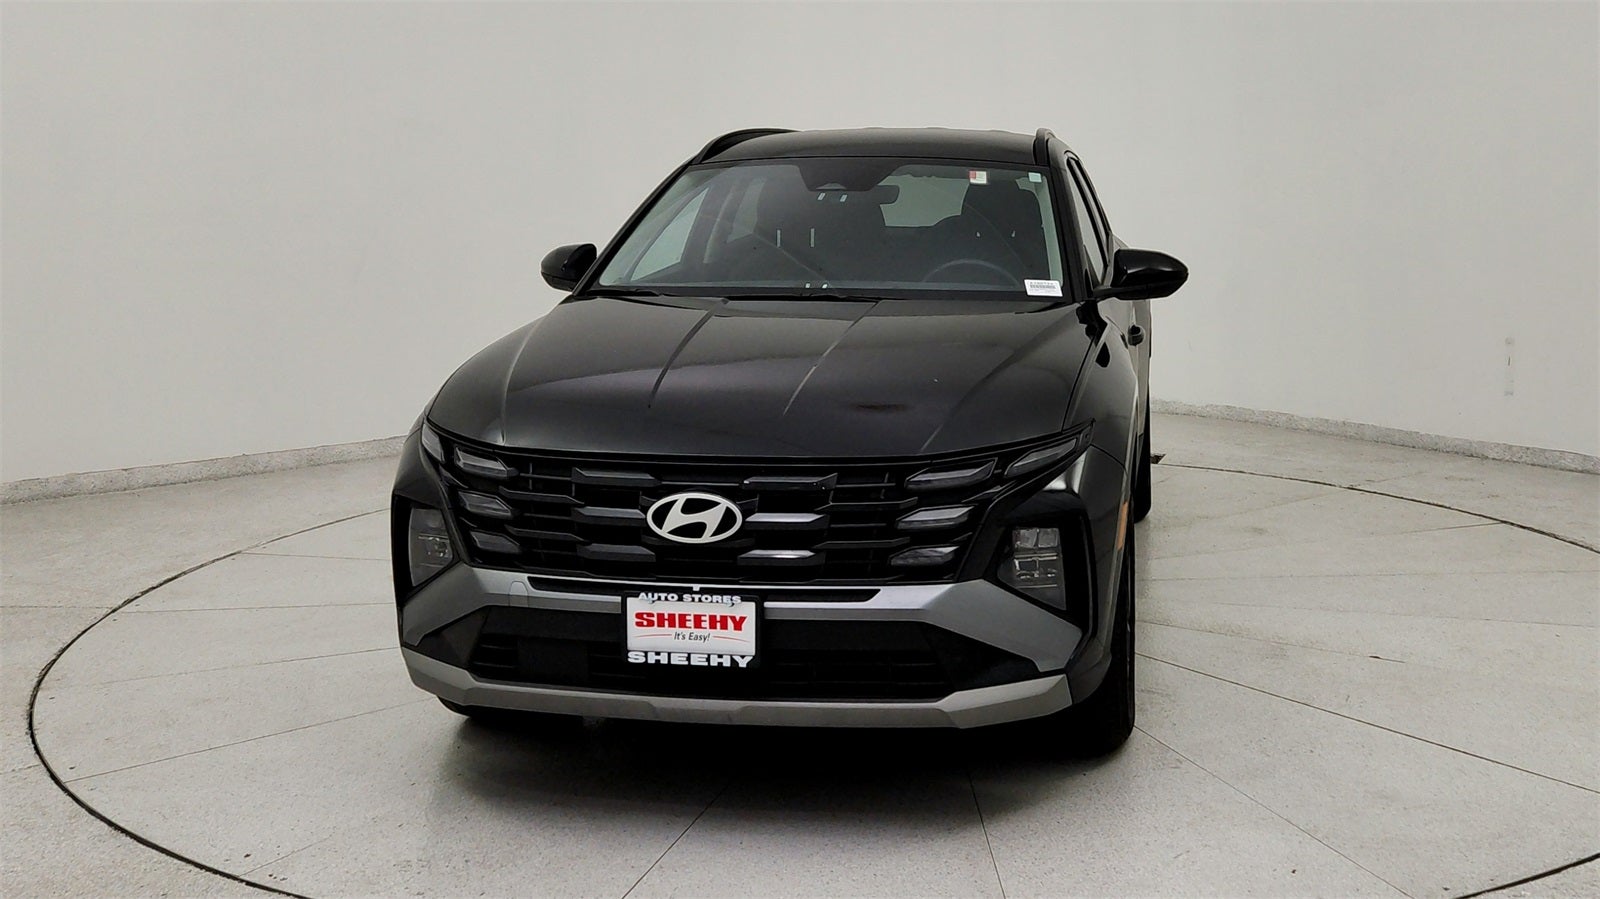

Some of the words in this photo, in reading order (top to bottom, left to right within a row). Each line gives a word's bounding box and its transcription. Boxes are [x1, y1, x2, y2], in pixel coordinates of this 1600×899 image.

[639, 592, 679, 602] AUTO
[682, 593, 741, 604] STORES
[635, 612, 748, 631] SHEEHY
[673, 632, 686, 641] It's
[688, 632, 711, 643] Easy!
[627, 651, 753, 668] SHEEHY
